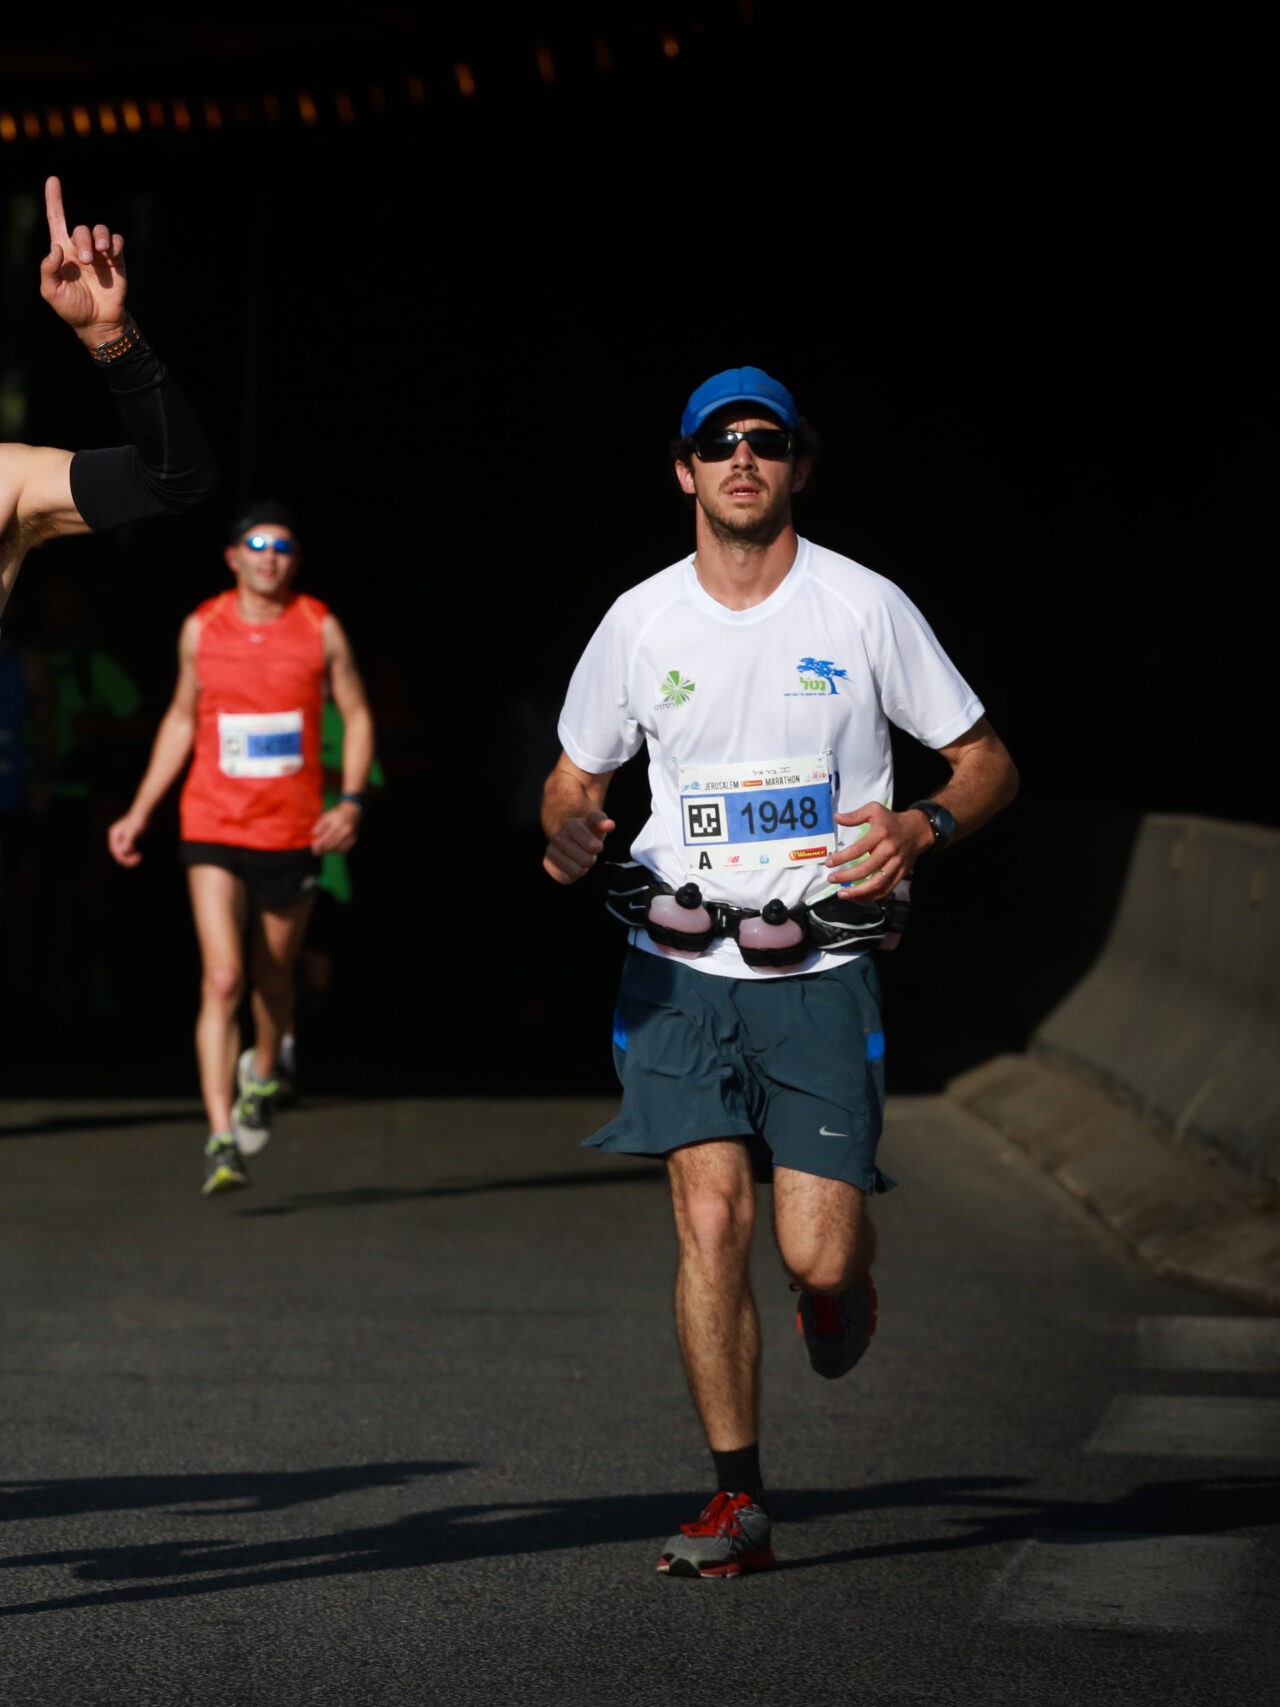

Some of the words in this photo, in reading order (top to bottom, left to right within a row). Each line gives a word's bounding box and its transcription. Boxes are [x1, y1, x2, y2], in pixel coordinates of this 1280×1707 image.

[704, 781, 739, 791] JERUSALEM
[765, 775, 800, 786] MARATHON
[741, 796, 818, 835] 1948
[698, 851, 712, 870] A
[796, 849, 826, 859] Winner
